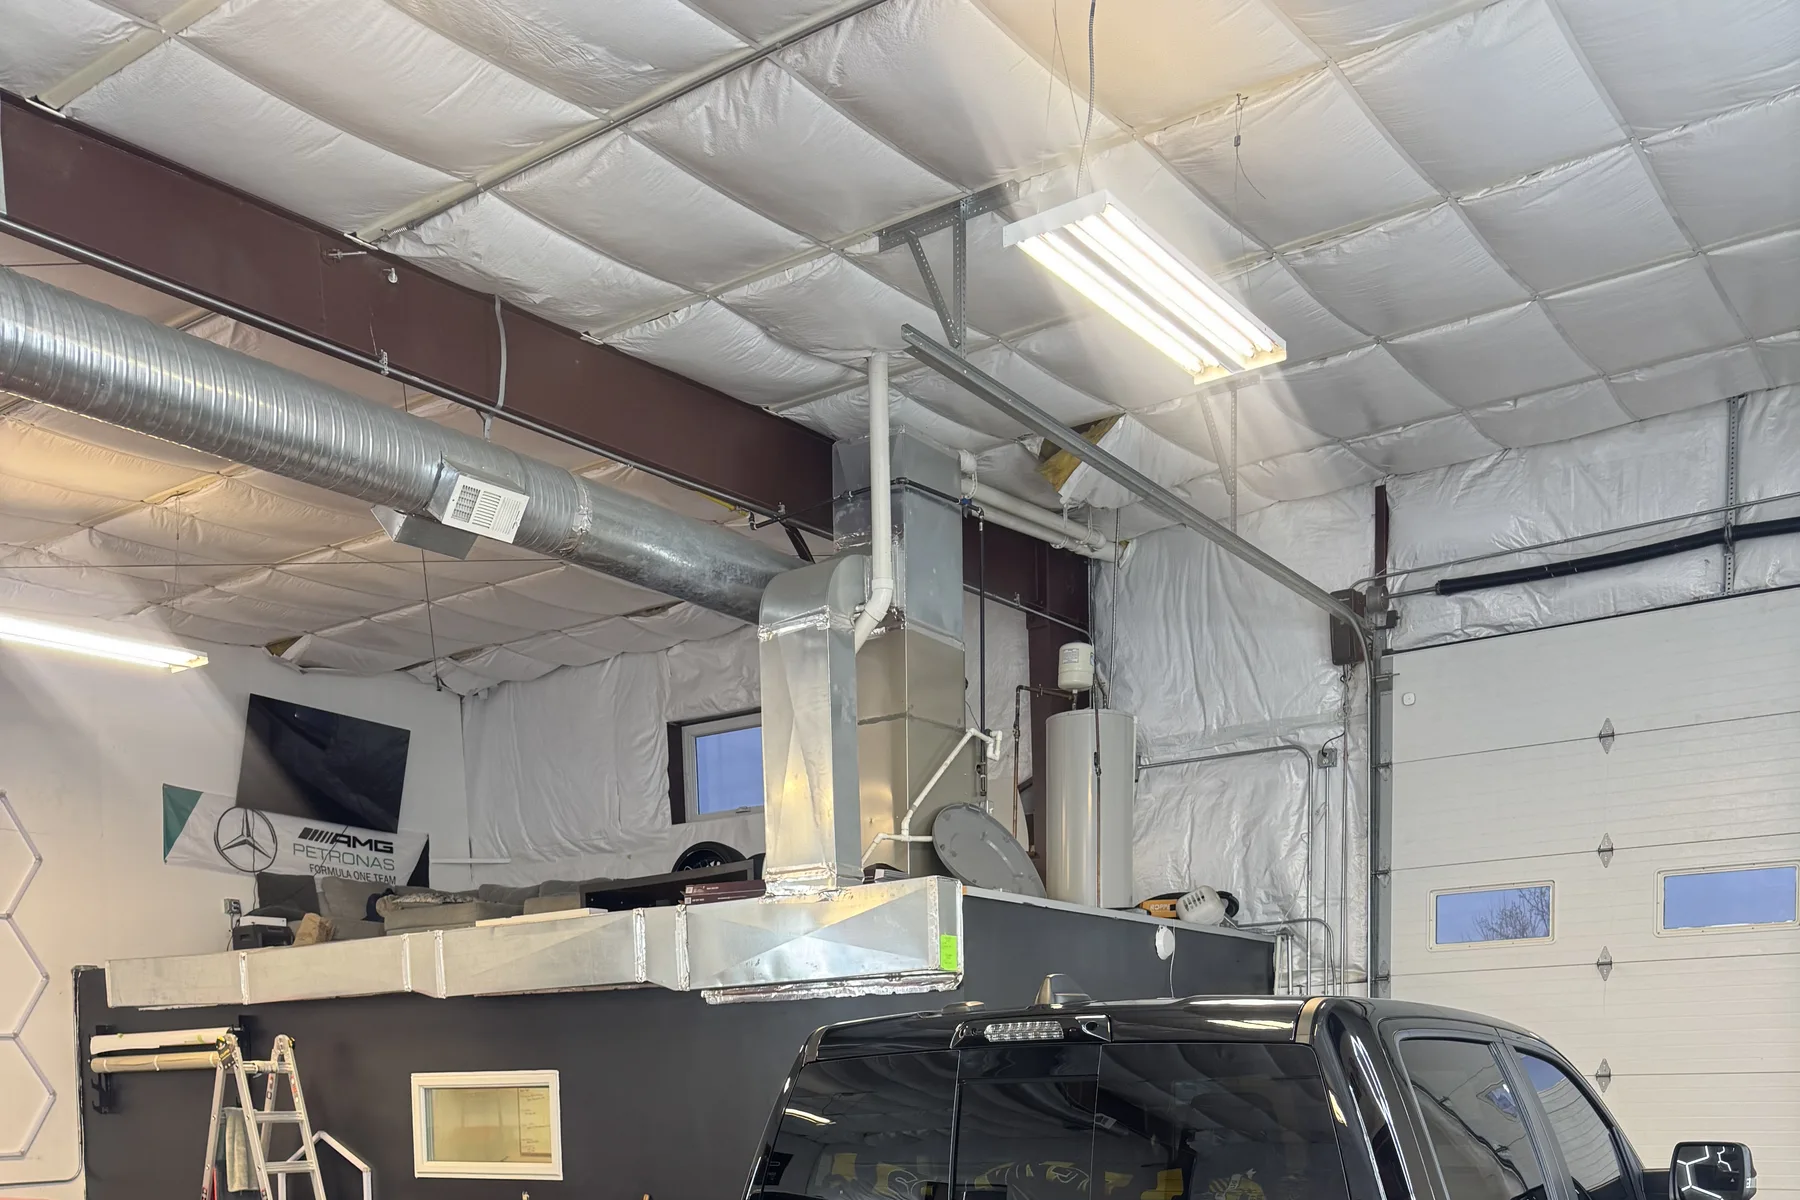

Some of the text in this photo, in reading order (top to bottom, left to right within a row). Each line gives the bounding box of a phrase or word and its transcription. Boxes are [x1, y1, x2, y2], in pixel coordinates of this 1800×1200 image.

[330, 833, 394, 854] AMG
[293, 843, 395, 871] PETRONAS
[309, 863, 397, 885] FORMULA ONE TEAM
